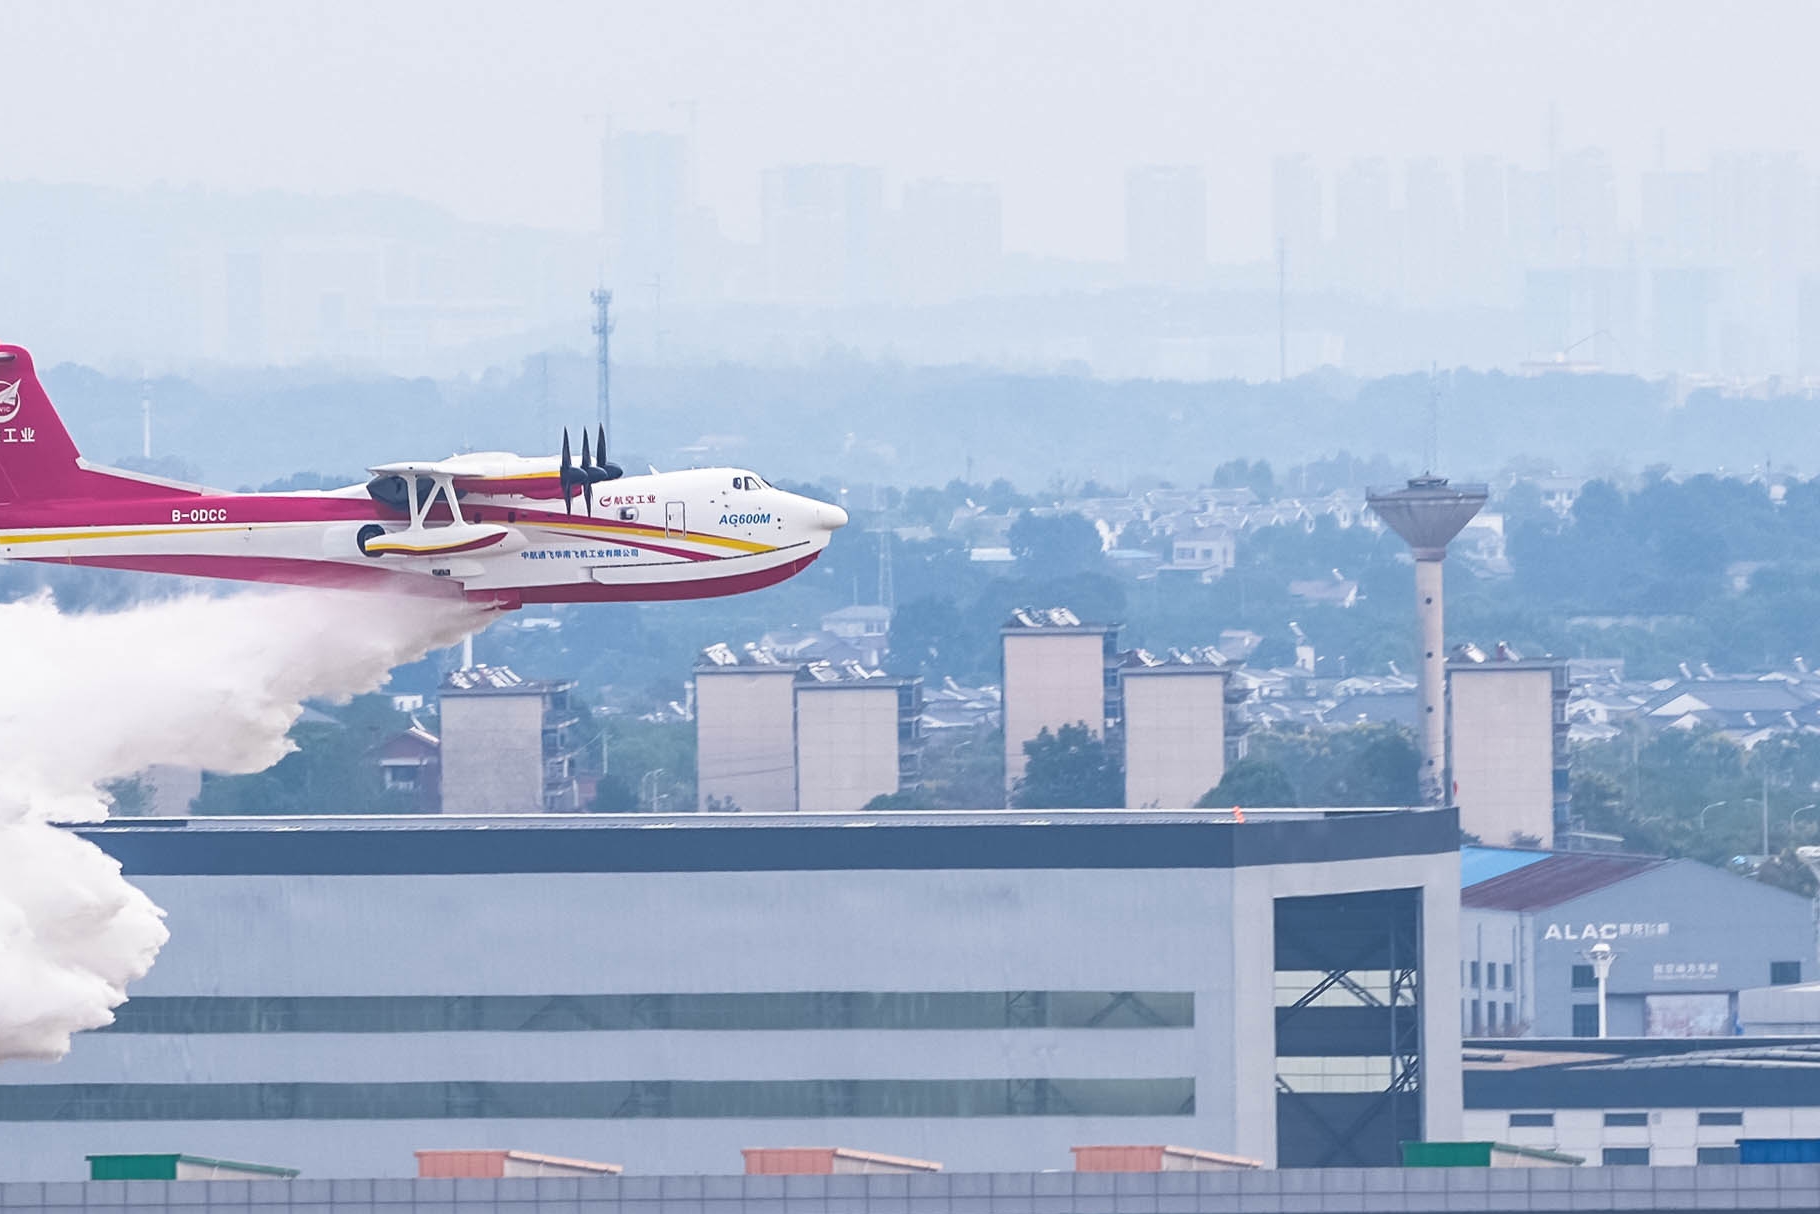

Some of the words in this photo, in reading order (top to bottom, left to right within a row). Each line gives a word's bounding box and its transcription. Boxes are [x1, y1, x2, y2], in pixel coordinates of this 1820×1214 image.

[614, 494, 656, 505] 航空工业
[719, 513, 771, 525] AG600M
